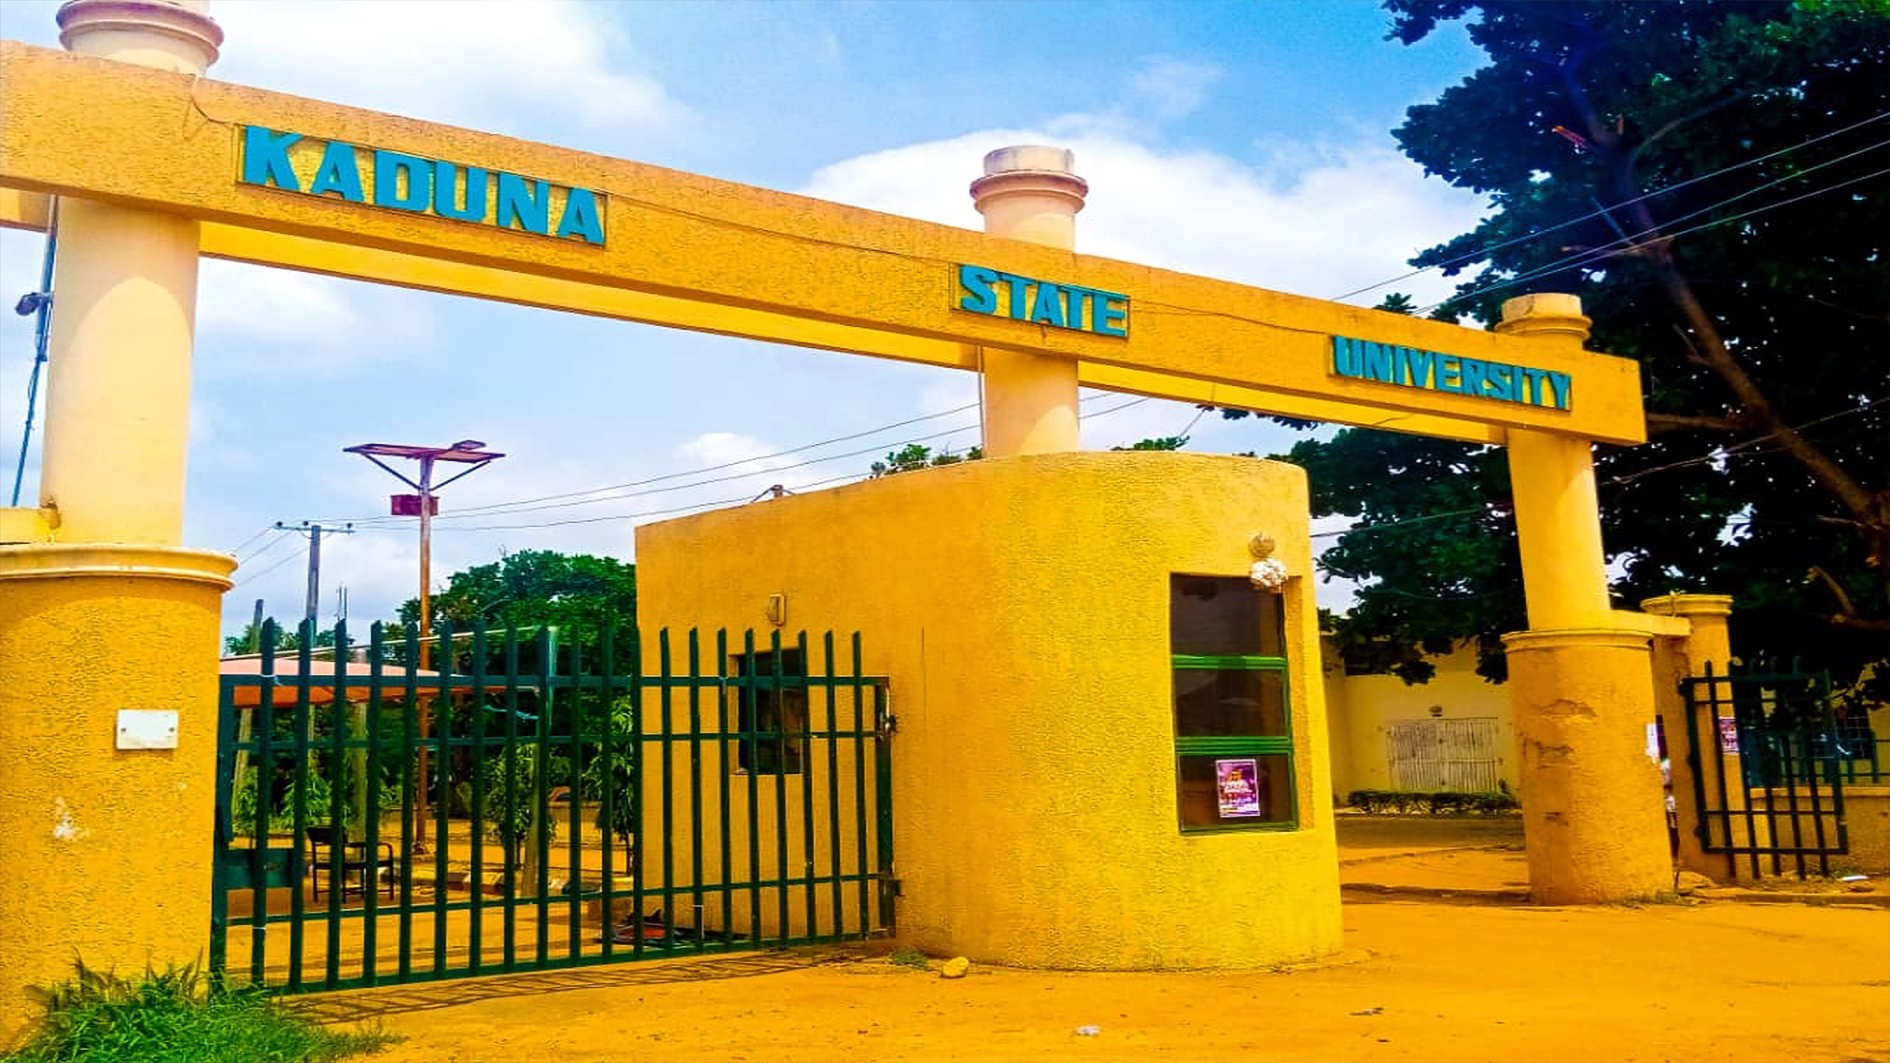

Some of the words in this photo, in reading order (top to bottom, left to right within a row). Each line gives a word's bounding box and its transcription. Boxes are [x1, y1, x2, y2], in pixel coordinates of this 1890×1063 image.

[244, 125, 605, 245] KADUNA
[960, 264, 1128, 337] STATE
[1333, 335, 1571, 410] UNIVERSITY
